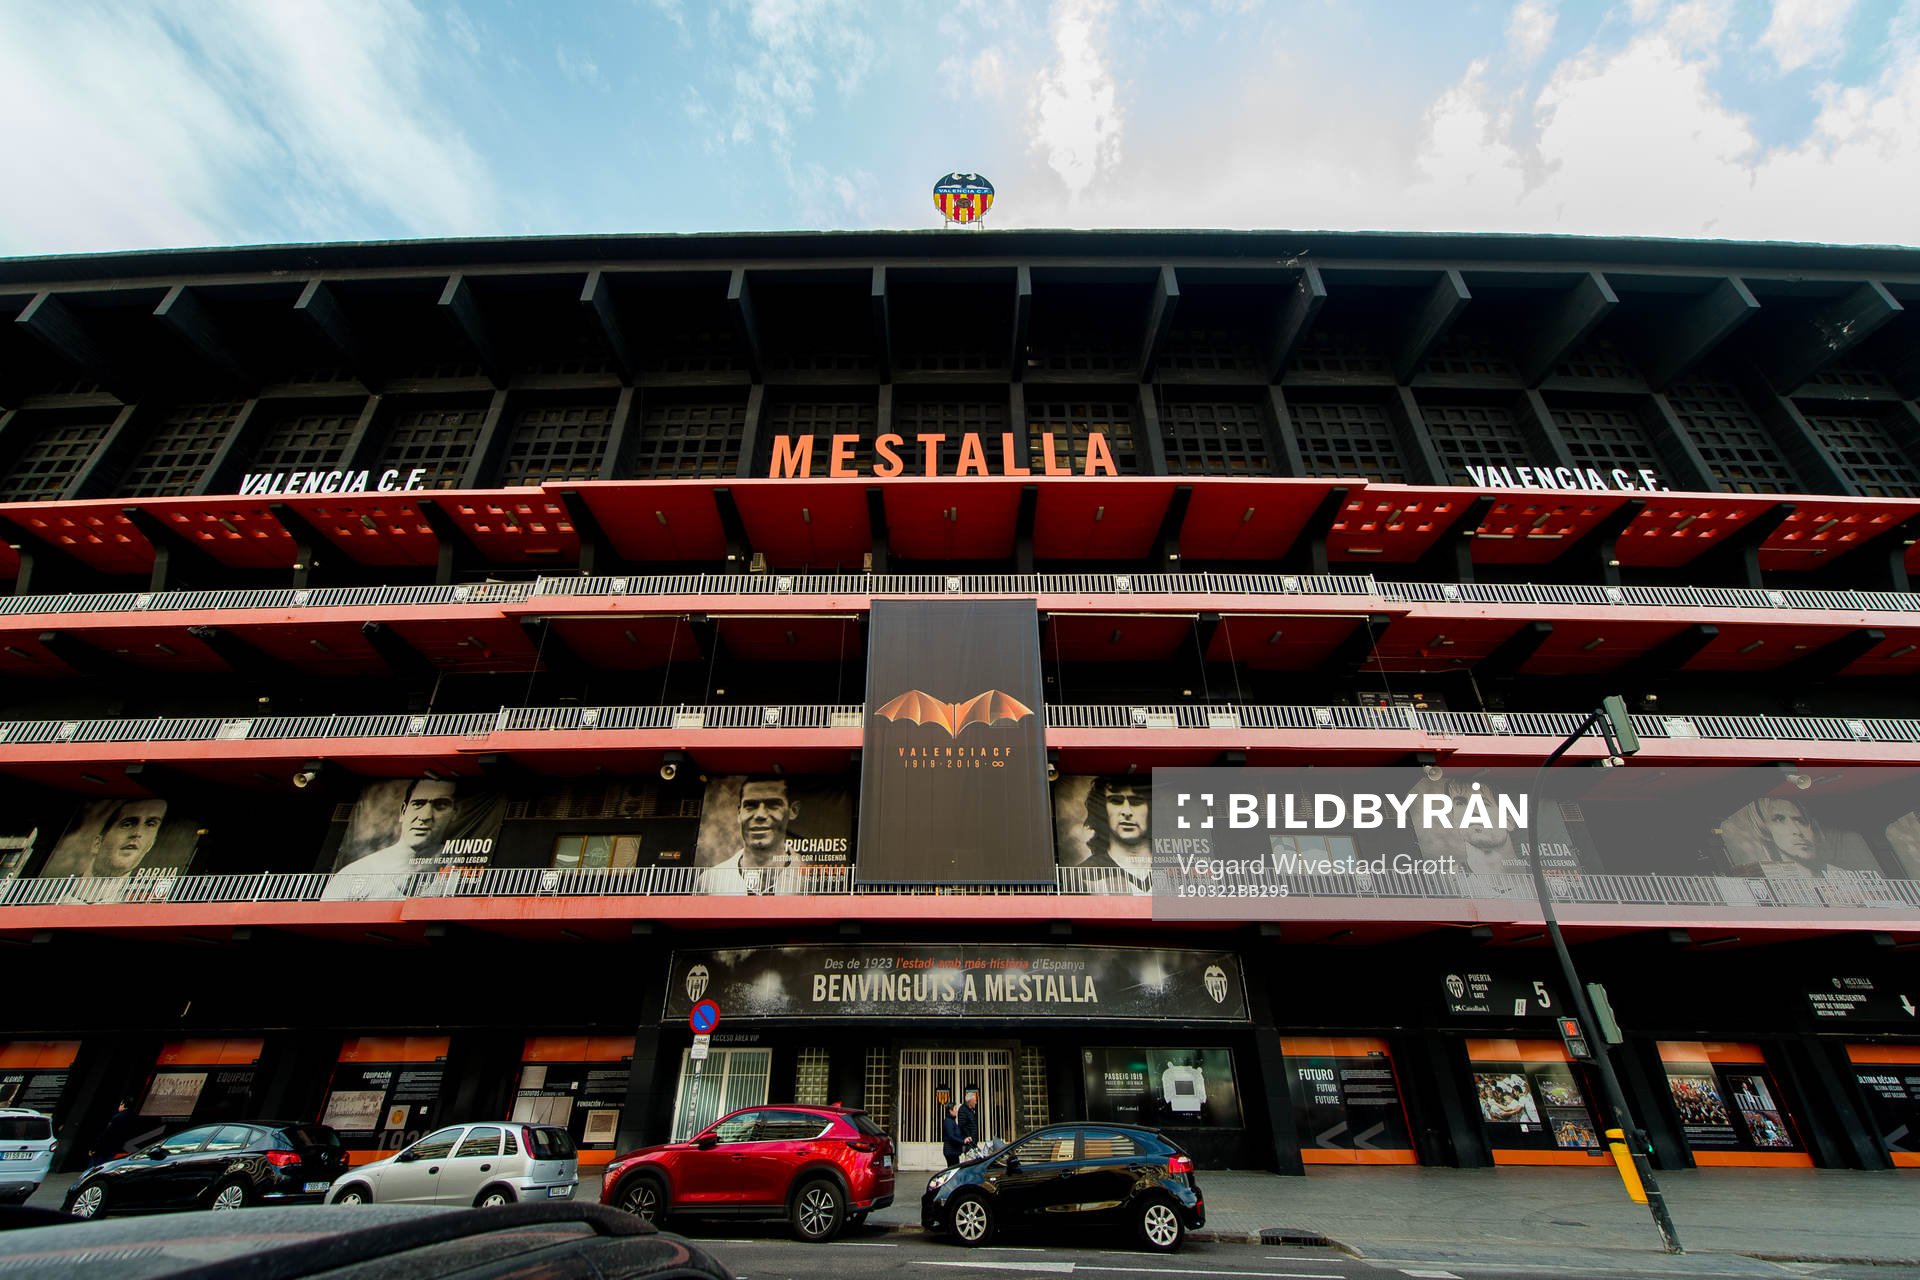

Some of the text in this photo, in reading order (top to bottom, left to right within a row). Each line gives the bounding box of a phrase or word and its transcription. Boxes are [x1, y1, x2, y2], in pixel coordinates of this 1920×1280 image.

[768, 432, 1119, 479] MESTALLA
[238, 468, 427, 496] VALENCIA C.F.
[1465, 465, 1671, 492] VALENCIA C.F.
[441, 838, 493, 855] MUNDO
[1154, 838, 1211, 854] KEMPES
[1520, 842, 1572, 857] AELDA
[433, 856, 454, 864] HEART
[453, 856, 466, 864] AND
[466, 856, 489, 864] LEGEND
[801, 854, 814, 862] COR
[818, 854, 847, 862] LLEGENDA
[824, 958, 846, 969] Des
[847, 958, 860, 969] de
[864, 958, 893, 969] 1923
[896, 958, 935, 969] l'estadi
[937, 958, 962, 969] amb
[964, 958, 987, 969] més
[1032, 958, 1085, 971] d'Espanya
[1467, 973, 1492, 982] PUERTA
[812, 974, 1099, 1003] BENVINGUTS A MESTALLA
[1470, 983, 1489, 991] PORTA
[1532, 981, 1551, 1008] 5
[1808, 993, 1867, 1002] PUNTO DE ENCUENTRO
[1813, 1002, 1827, 1010] PUNT
[712, 1034, 734, 1042] ACCESO
[1104, 1072, 1143, 1080] PASSEIG 1919
[1298, 1068, 1335, 1081] FUTURO
[1316, 1083, 1337, 1092] FUTUR
[1314, 1095, 1340, 1105] FUTURE
